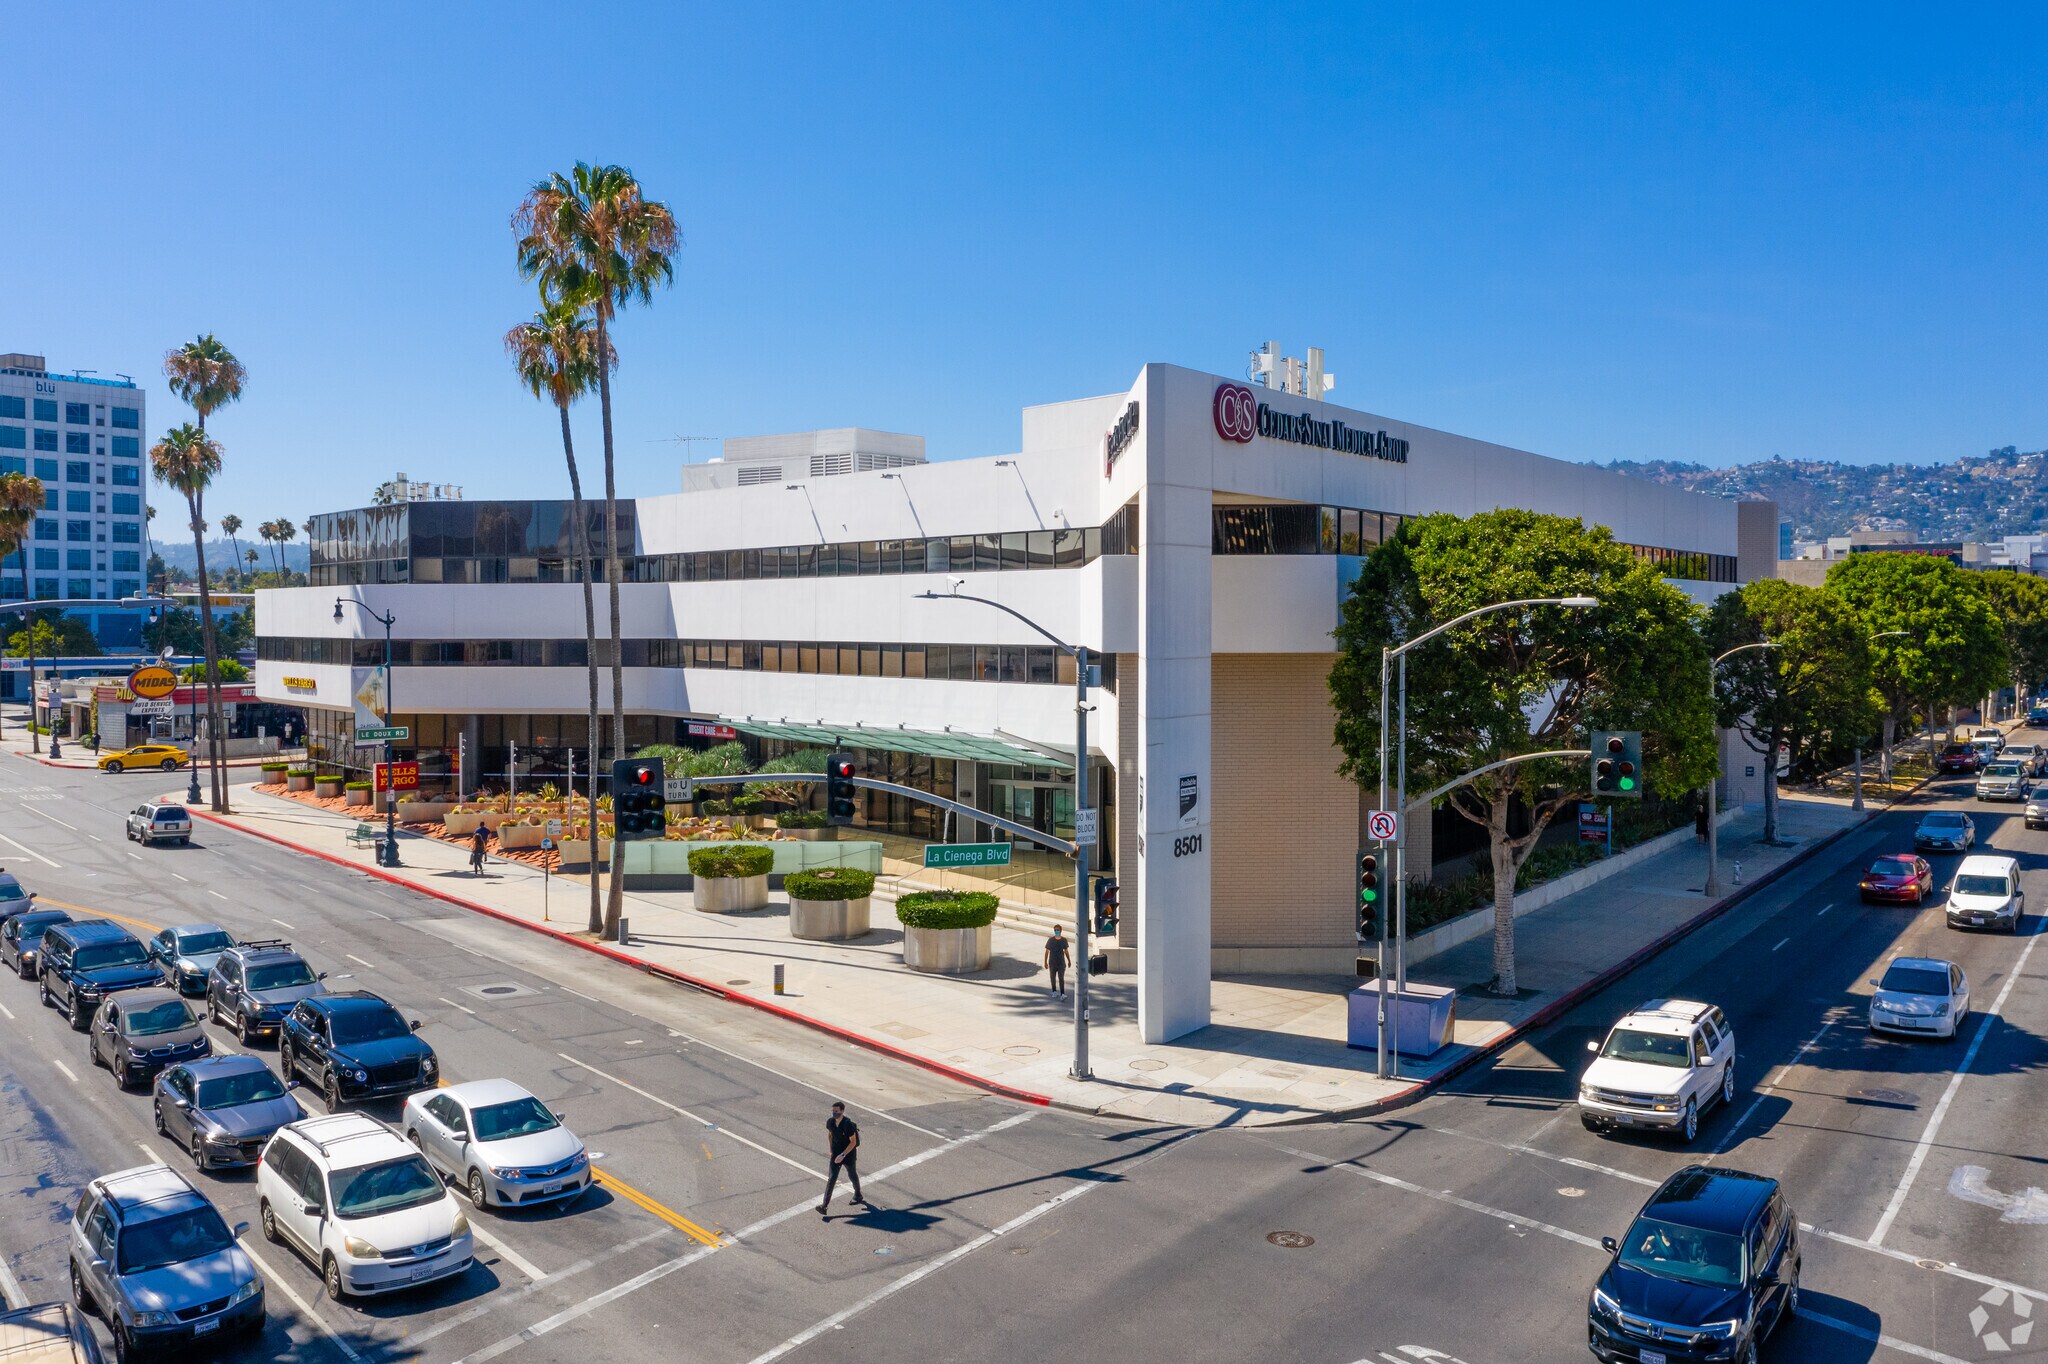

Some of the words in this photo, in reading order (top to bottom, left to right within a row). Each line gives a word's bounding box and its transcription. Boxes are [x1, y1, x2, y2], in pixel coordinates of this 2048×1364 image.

[1332, 420, 1377, 457] MEDICAL
[1377, 430, 1409, 463] GROUP
[135, 678, 174, 687] MIDAS
[116, 688, 136, 700] MID
[689, 725, 704, 734] URGENT
[380, 776, 416, 786] FRGO
[680, 780, 687, 789] U
[1076, 813, 1084, 822] DO
[1085, 811, 1096, 821] NOT
[1077, 824, 1096, 834] BLOCK
[1174, 834, 1202, 858] 8501
[927, 851, 940, 862] La
[943, 850, 983, 864] Cienega
[986, 848, 1008, 860] Blvd
